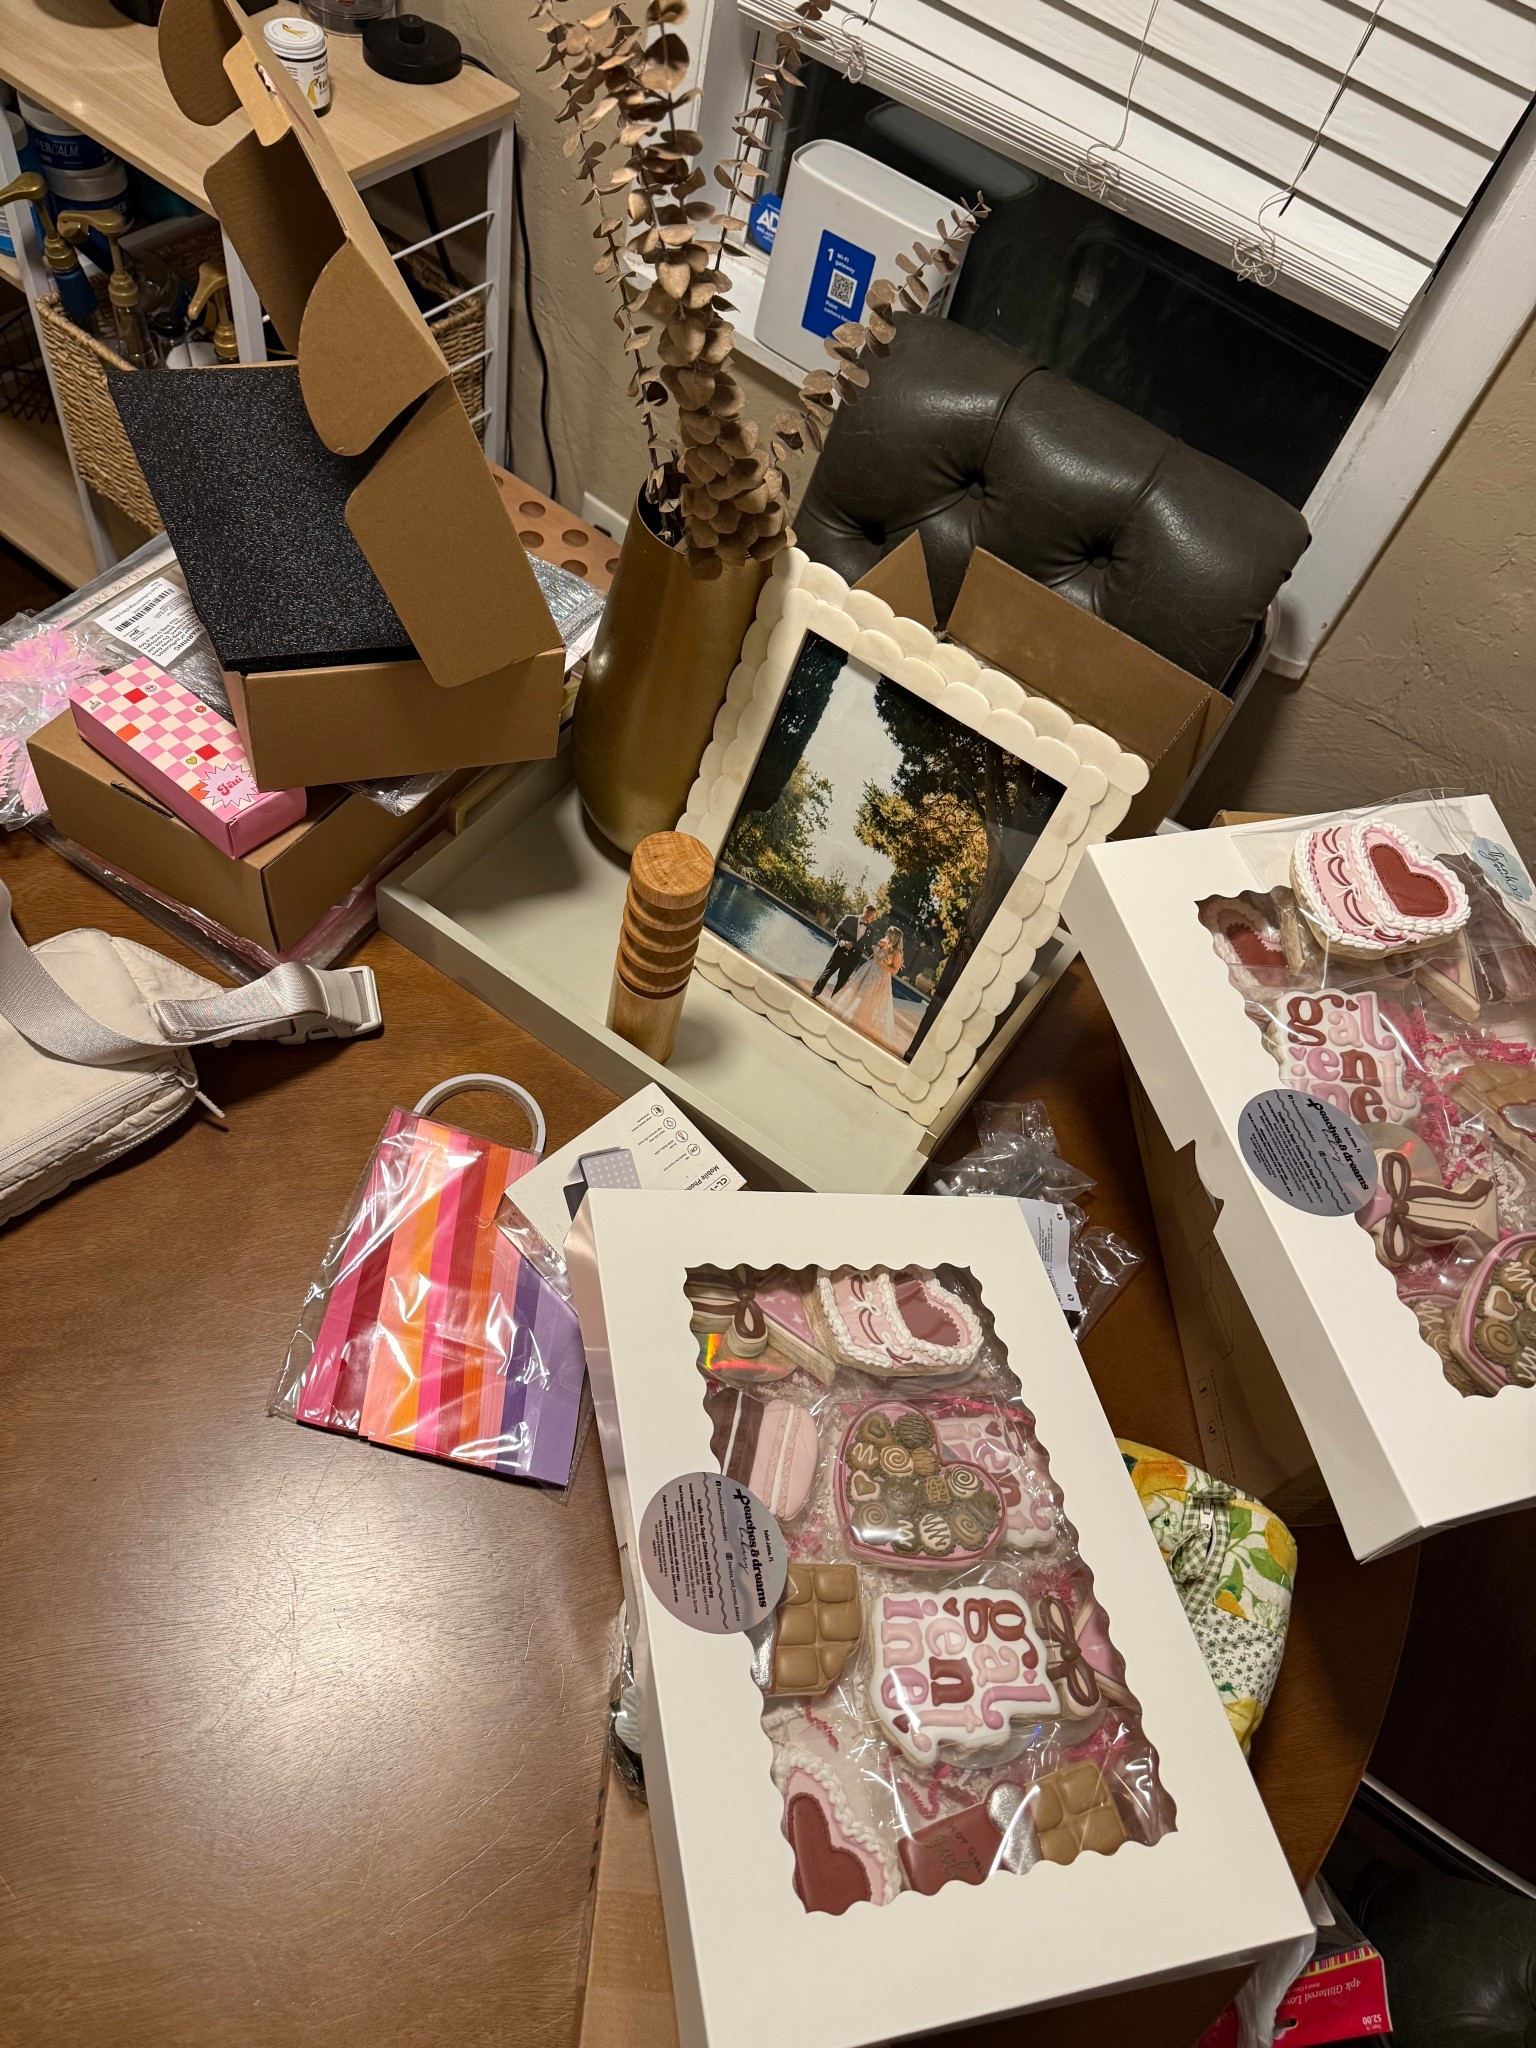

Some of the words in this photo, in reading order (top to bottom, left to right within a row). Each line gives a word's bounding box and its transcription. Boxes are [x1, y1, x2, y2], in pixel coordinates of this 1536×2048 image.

[757, 209, 782, 233] AD
[827, 248, 834, 262] 1
[835, 252, 850, 263] Wi-Fi
[833, 258, 856, 275] gateway
[823, 307, 841, 319] camera
[824, 299, 838, 310] Point
[78, 589, 112, 614] MAKE
[121, 568, 149, 587] FUN
[173, 625, 202, 652] WARNING
[1337, 1142, 1347, 1152] &
[700, 1164, 719, 1181] Mobile
[1341, 1149, 1370, 1191] dreams
[701, 1541, 709, 1560] Cookies
[750, 1548, 759, 1558] &
[751, 1557, 769, 1608] dreams
[963, 1597, 1056, 1730] gal
[1303, 1982, 1344, 2001] Glittered
[1343, 1976, 1362, 1991] 4pk
[1360, 2013, 1383, 2026] $2.00
